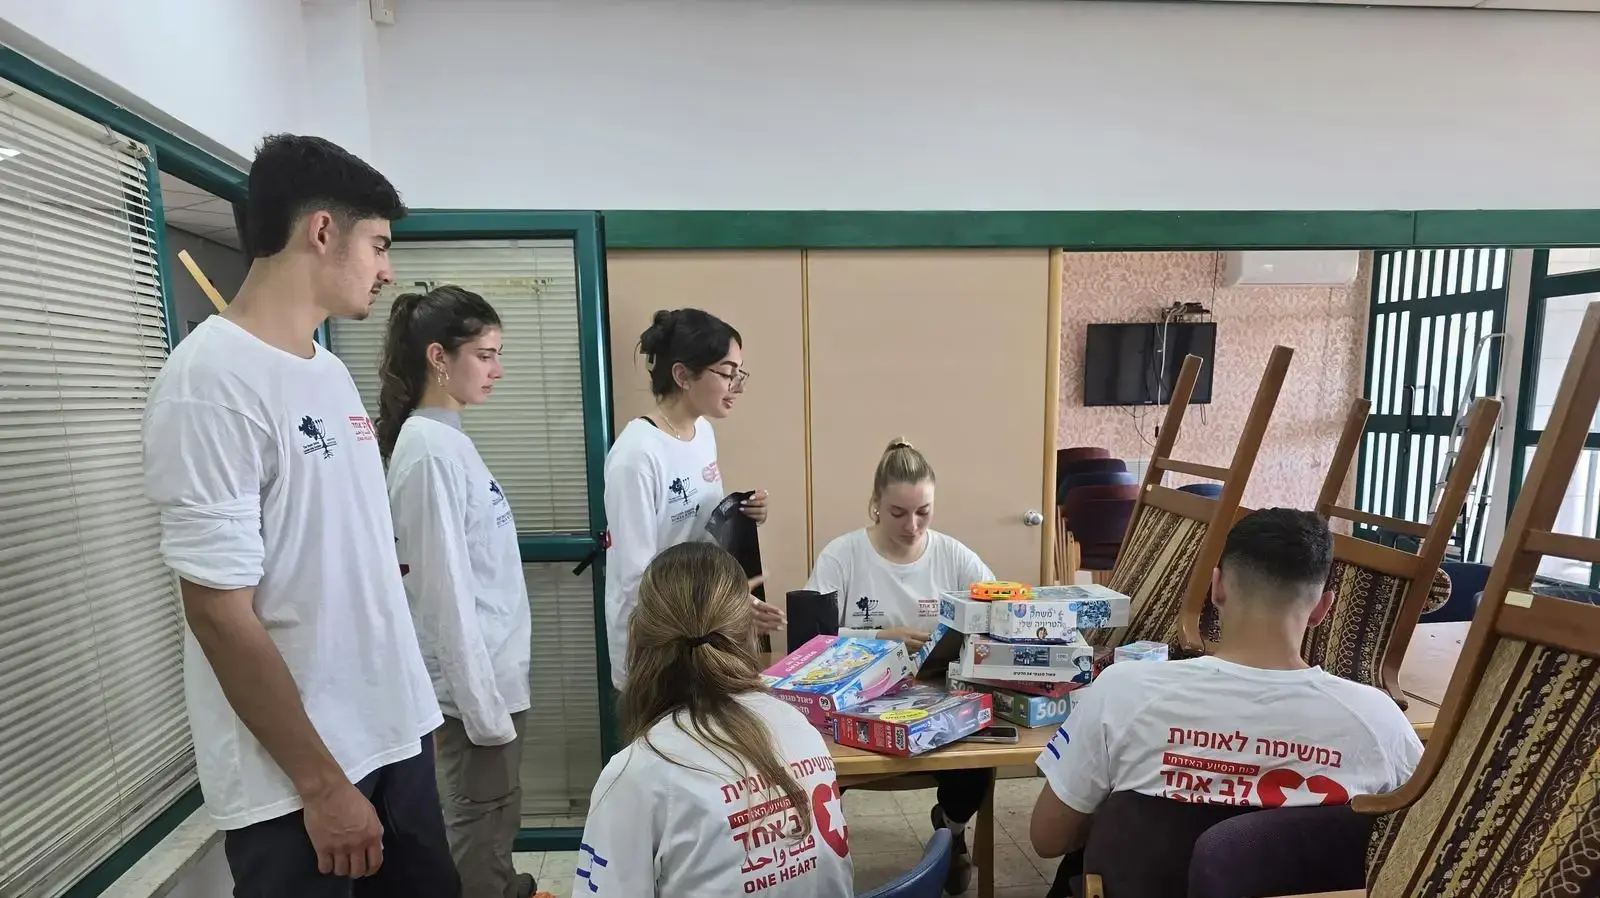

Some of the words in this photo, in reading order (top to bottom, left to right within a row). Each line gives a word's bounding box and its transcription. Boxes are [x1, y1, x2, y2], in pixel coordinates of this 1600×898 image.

[1018, 619, 1032, 629] שלי
[1030, 610, 1053, 620] משחק
[797, 694, 814, 704] פאזל
[1036, 699, 1067, 720] 500
[1167, 727, 1249, 752] לאומית
[1167, 755, 1203, 768] האזרחי
[1255, 738, 1341, 769] במשימה
[1207, 761, 1235, 773] הסיוע
[1238, 766, 1255, 774] כוח
[1160, 770, 1213, 794] אחד
[1219, 776, 1253, 798] לב
[733, 820, 786, 852] אחד
[741, 846, 786, 874] واحد
[743, 873, 777, 893] ONE
[780, 856, 817, 882] HEART
